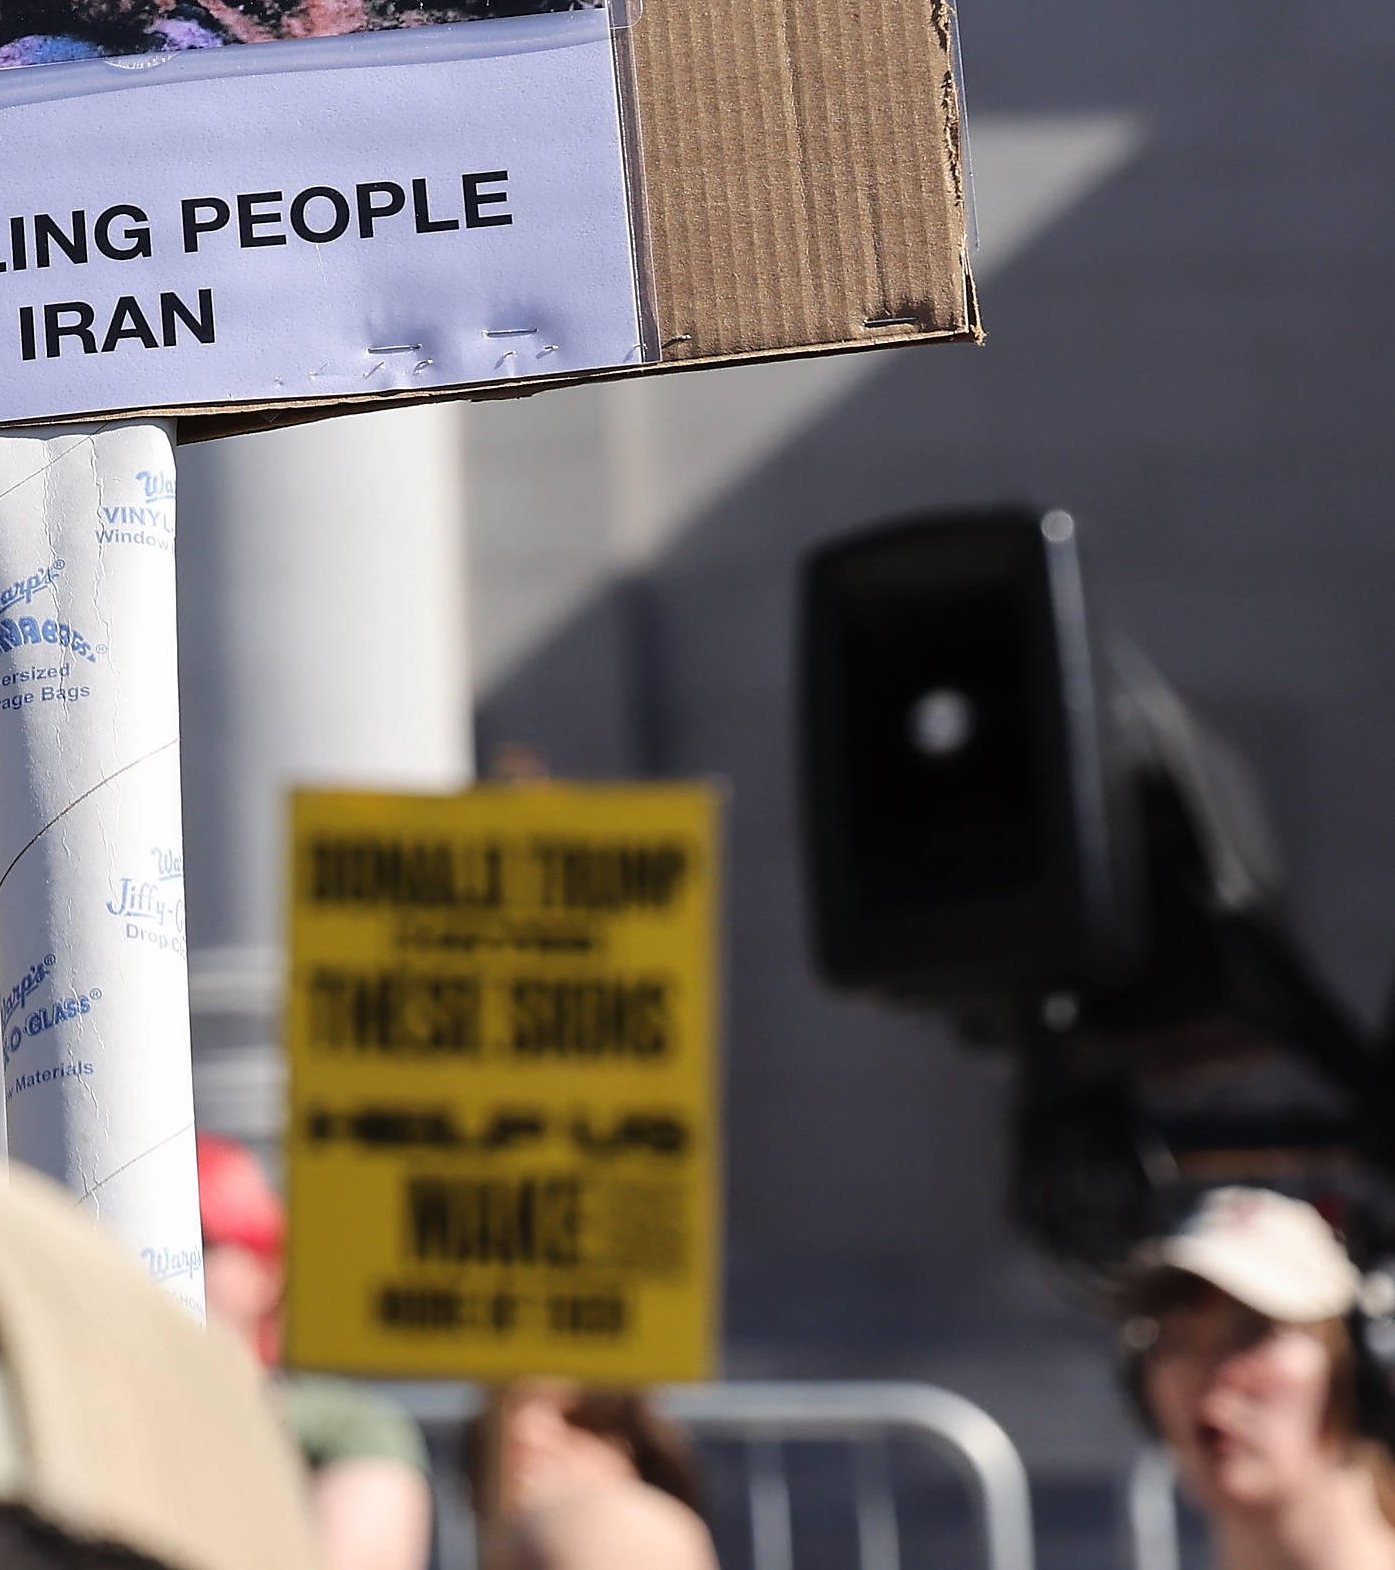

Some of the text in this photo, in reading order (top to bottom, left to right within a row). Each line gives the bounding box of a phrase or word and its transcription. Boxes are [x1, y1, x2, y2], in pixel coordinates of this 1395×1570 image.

[180, 169, 514, 255] PEOPLE
[18, 287, 215, 360] IRAN
[41, 685, 91, 703] Bags
[126, 923, 168, 949] Drop
[15, 1060, 95, 1094] Materials
